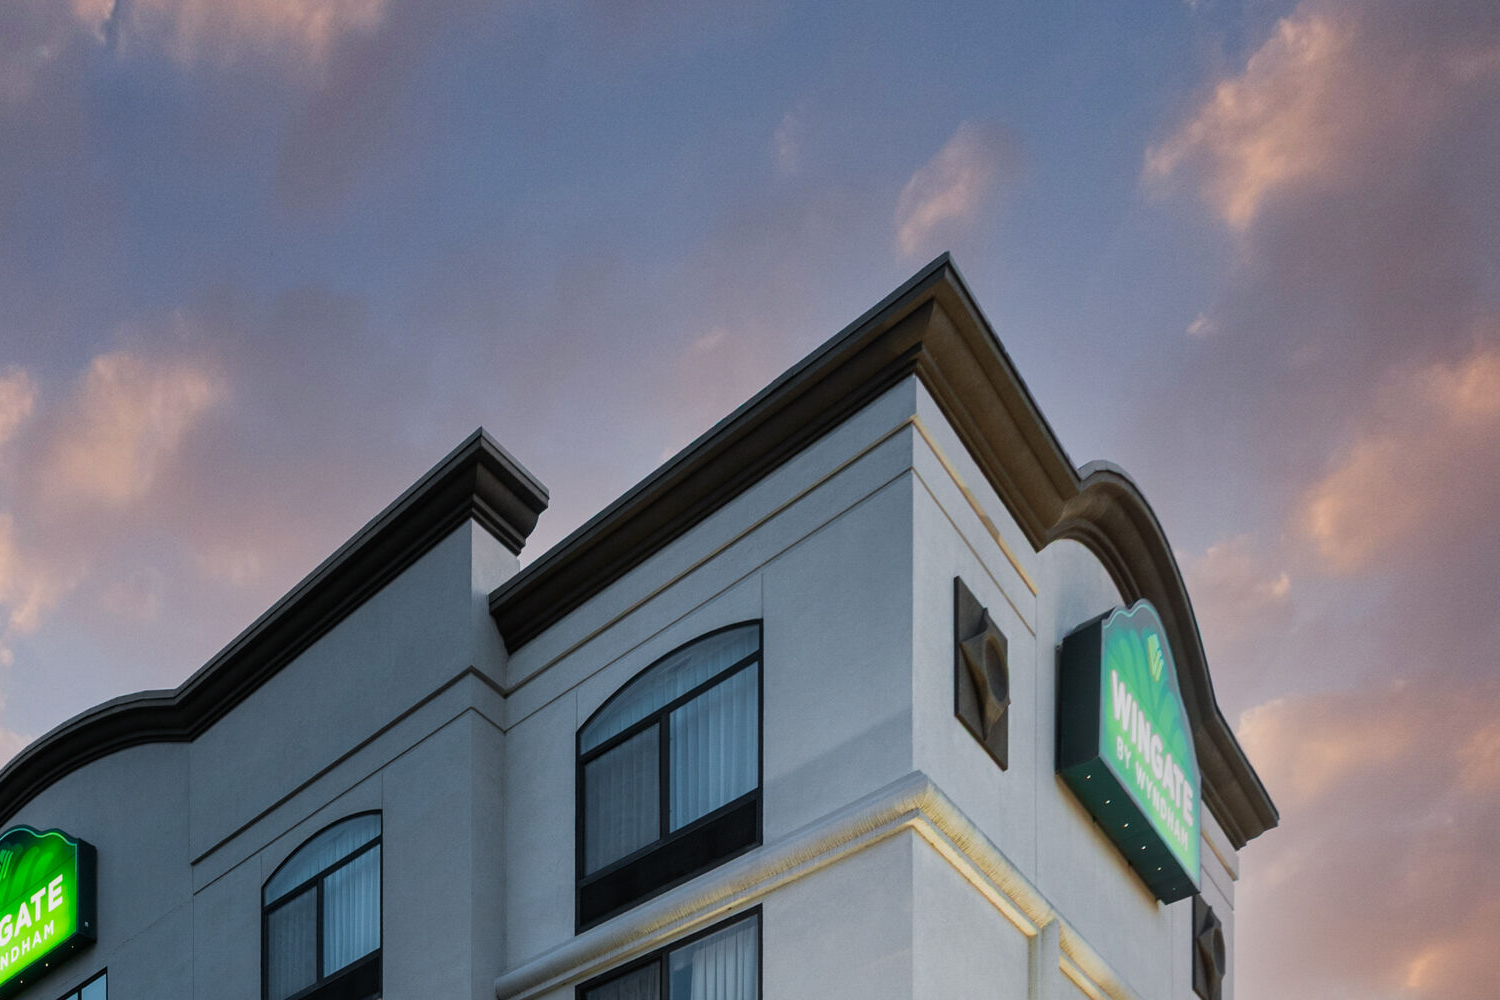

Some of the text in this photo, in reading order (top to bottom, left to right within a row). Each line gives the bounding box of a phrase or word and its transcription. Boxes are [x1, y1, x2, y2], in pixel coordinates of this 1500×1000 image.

[1110, 669, 1194, 827] WINGATE
[1116, 735, 1189, 851] BY WYNDHAM
